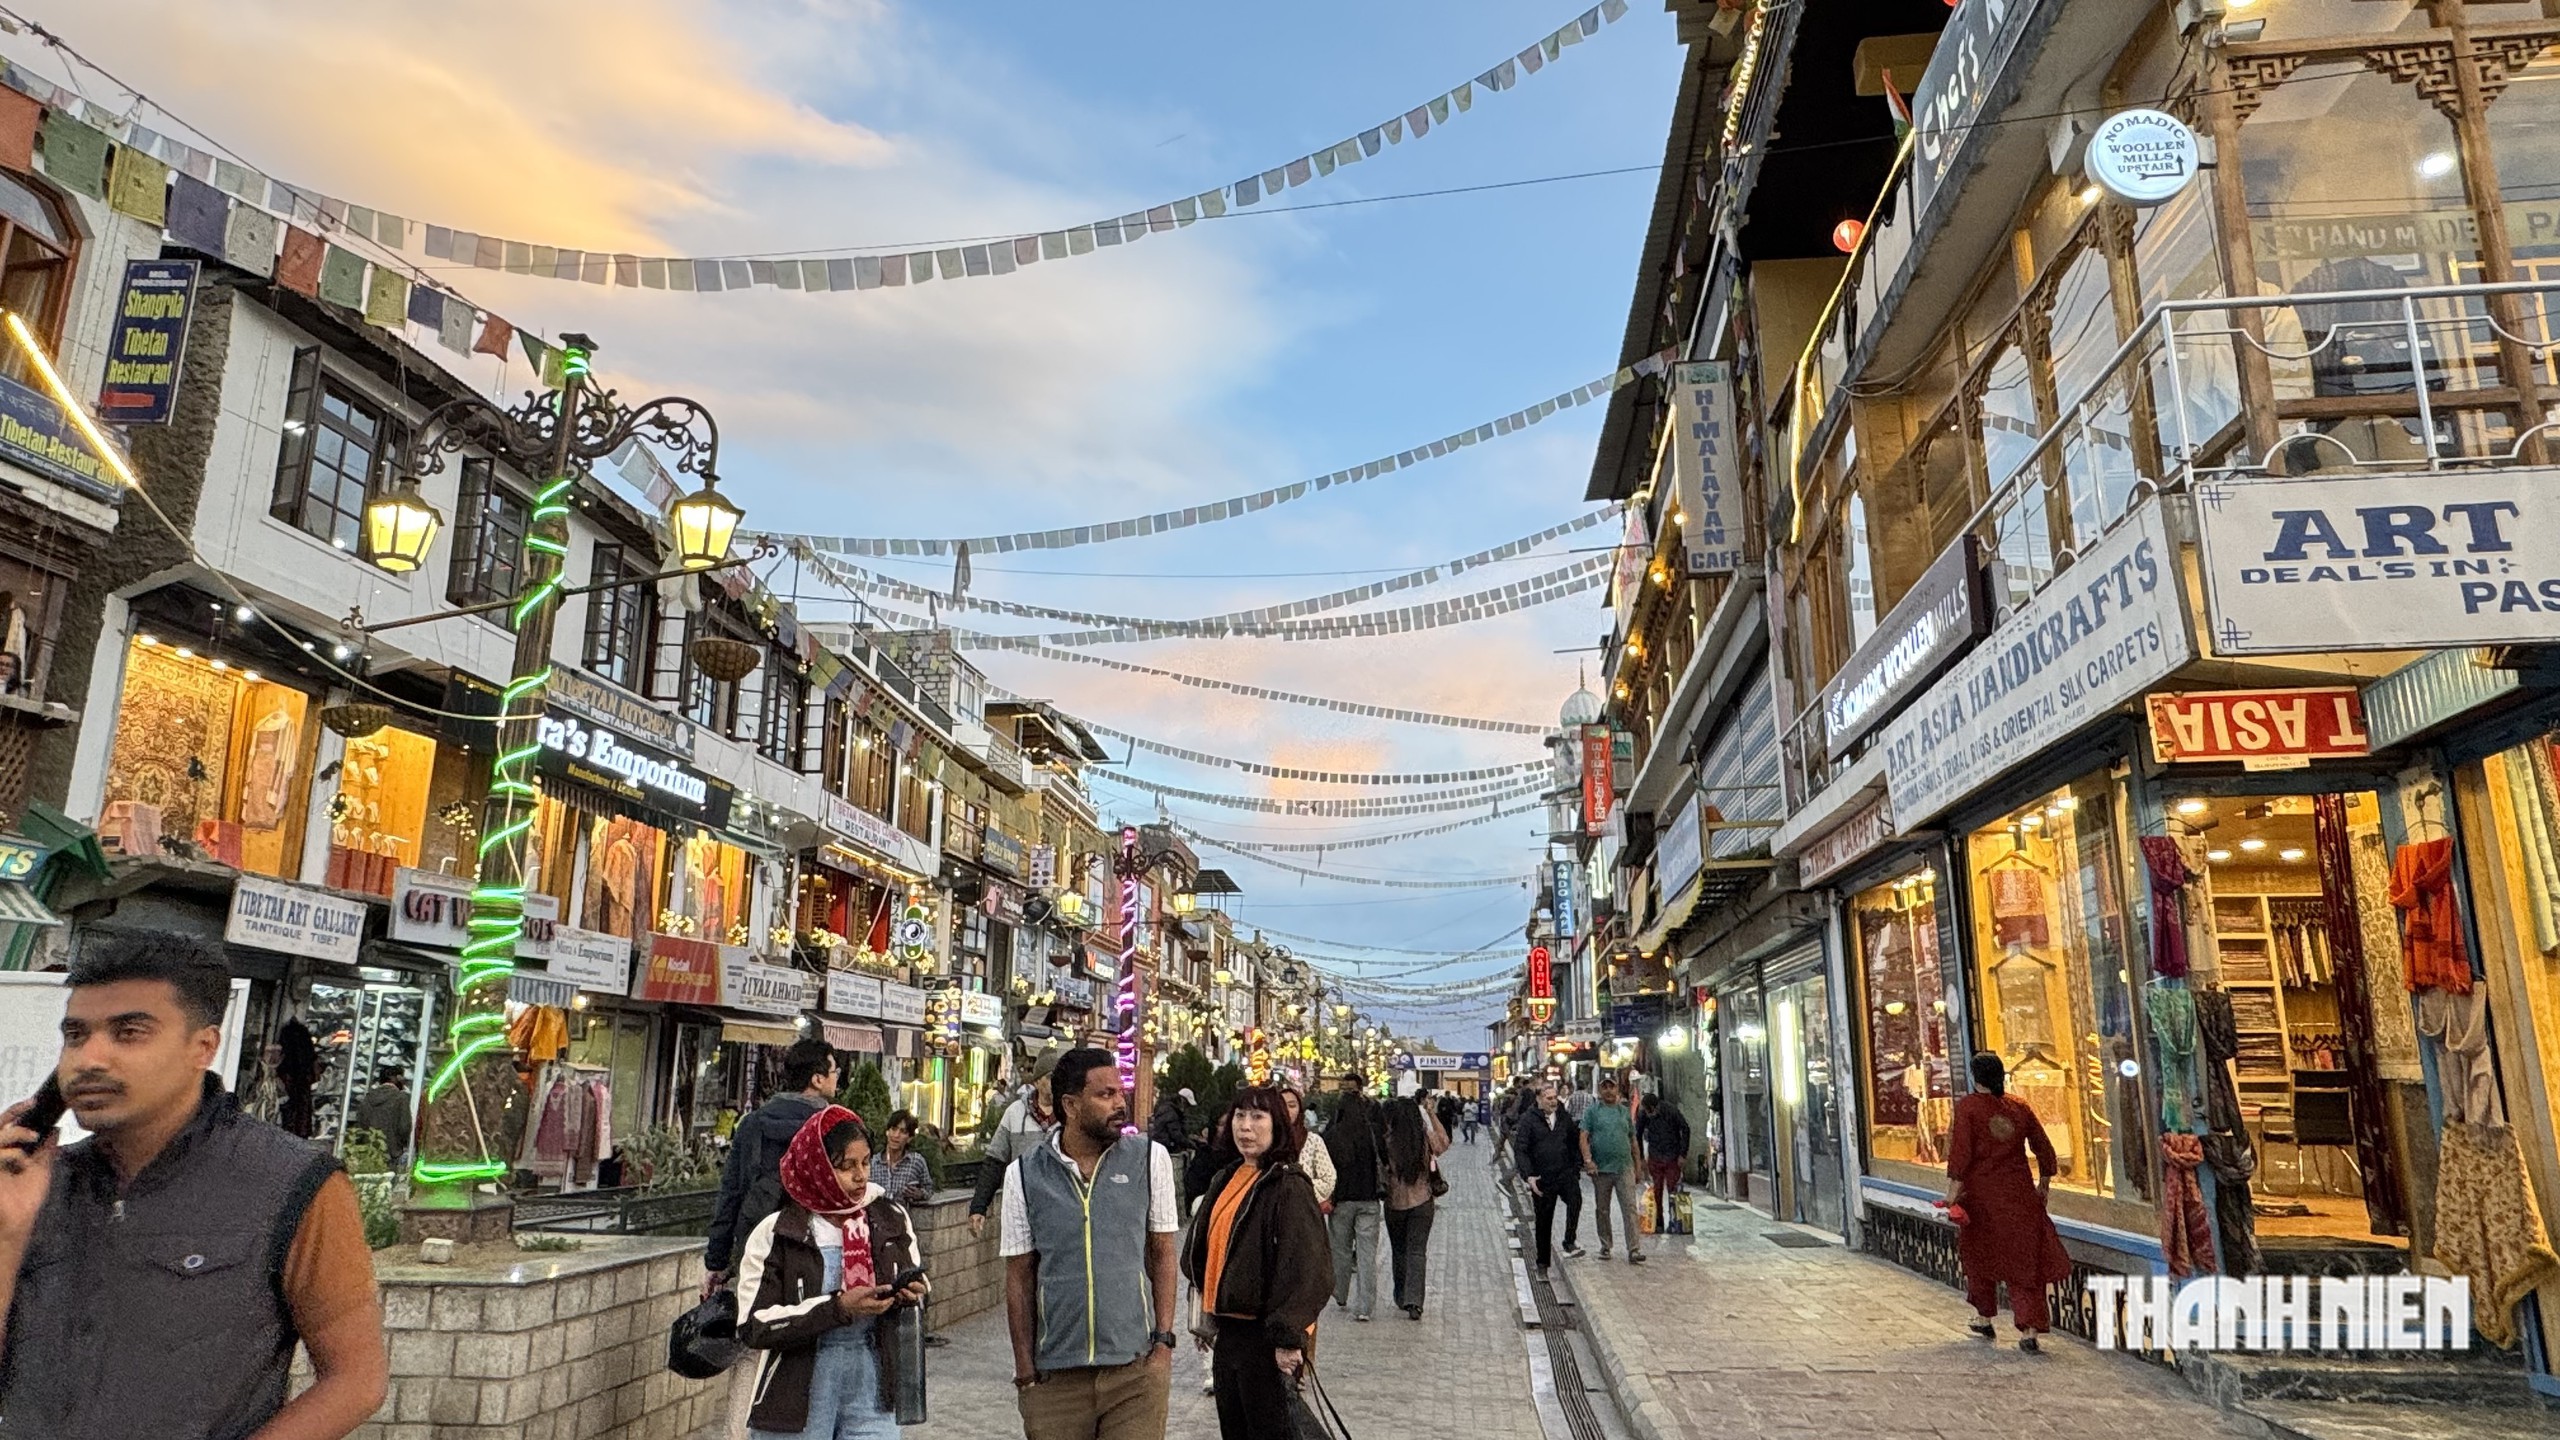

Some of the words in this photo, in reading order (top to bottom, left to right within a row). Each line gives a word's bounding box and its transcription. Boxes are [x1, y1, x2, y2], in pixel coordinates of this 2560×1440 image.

[1922, 27, 1980, 161] Chef's
[2105, 115, 2186, 143] NOMADIC
[2108, 140, 2185, 154] WOOLLEN
[2123, 152, 2174, 163] MILLS
[2118, 162, 2174, 173] UPSTAIR
[124, 289, 186, 320] Shangrila
[123, 327, 169, 356] Tibetan
[107, 359, 173, 385] Restaurant
[0, 413, 48, 455] Tibetan
[48, 435, 118, 487] Restaurant
[1692, 389, 1726, 545] HIMALAYAN
[2263, 501, 2520, 562] ART
[1691, 550, 1743, 570] CAFE
[2240, 560, 2416, 584] DEAL'S
[1882, 610, 1936, 689] WOOLLEN
[1935, 578, 1968, 637] MILLS
[1886, 729, 1916, 782] ART
[1920, 692, 1966, 758] ASIA
[1967, 536, 2158, 719] HANDICRAFTS
[1993, 726, 2001, 747] &
[2001, 691, 2058, 745] ORIENTAL
[2059, 668, 2087, 709] SILK
[2087, 620, 2160, 689] CARPETS
[2166, 698, 2307, 752] ASIA
[536, 715, 589, 758] ra's
[588, 728, 707, 804] Emporium
[0, 845, 38, 877] TS
[1556, 863, 1569, 897] AMDO
[237, 889, 286, 922] TIBETAN
[286, 901, 311, 928] ART
[313, 906, 361, 937] GALLERY
[404, 889, 448, 923] CAT
[244, 919, 303, 941] TANTRIQUE
